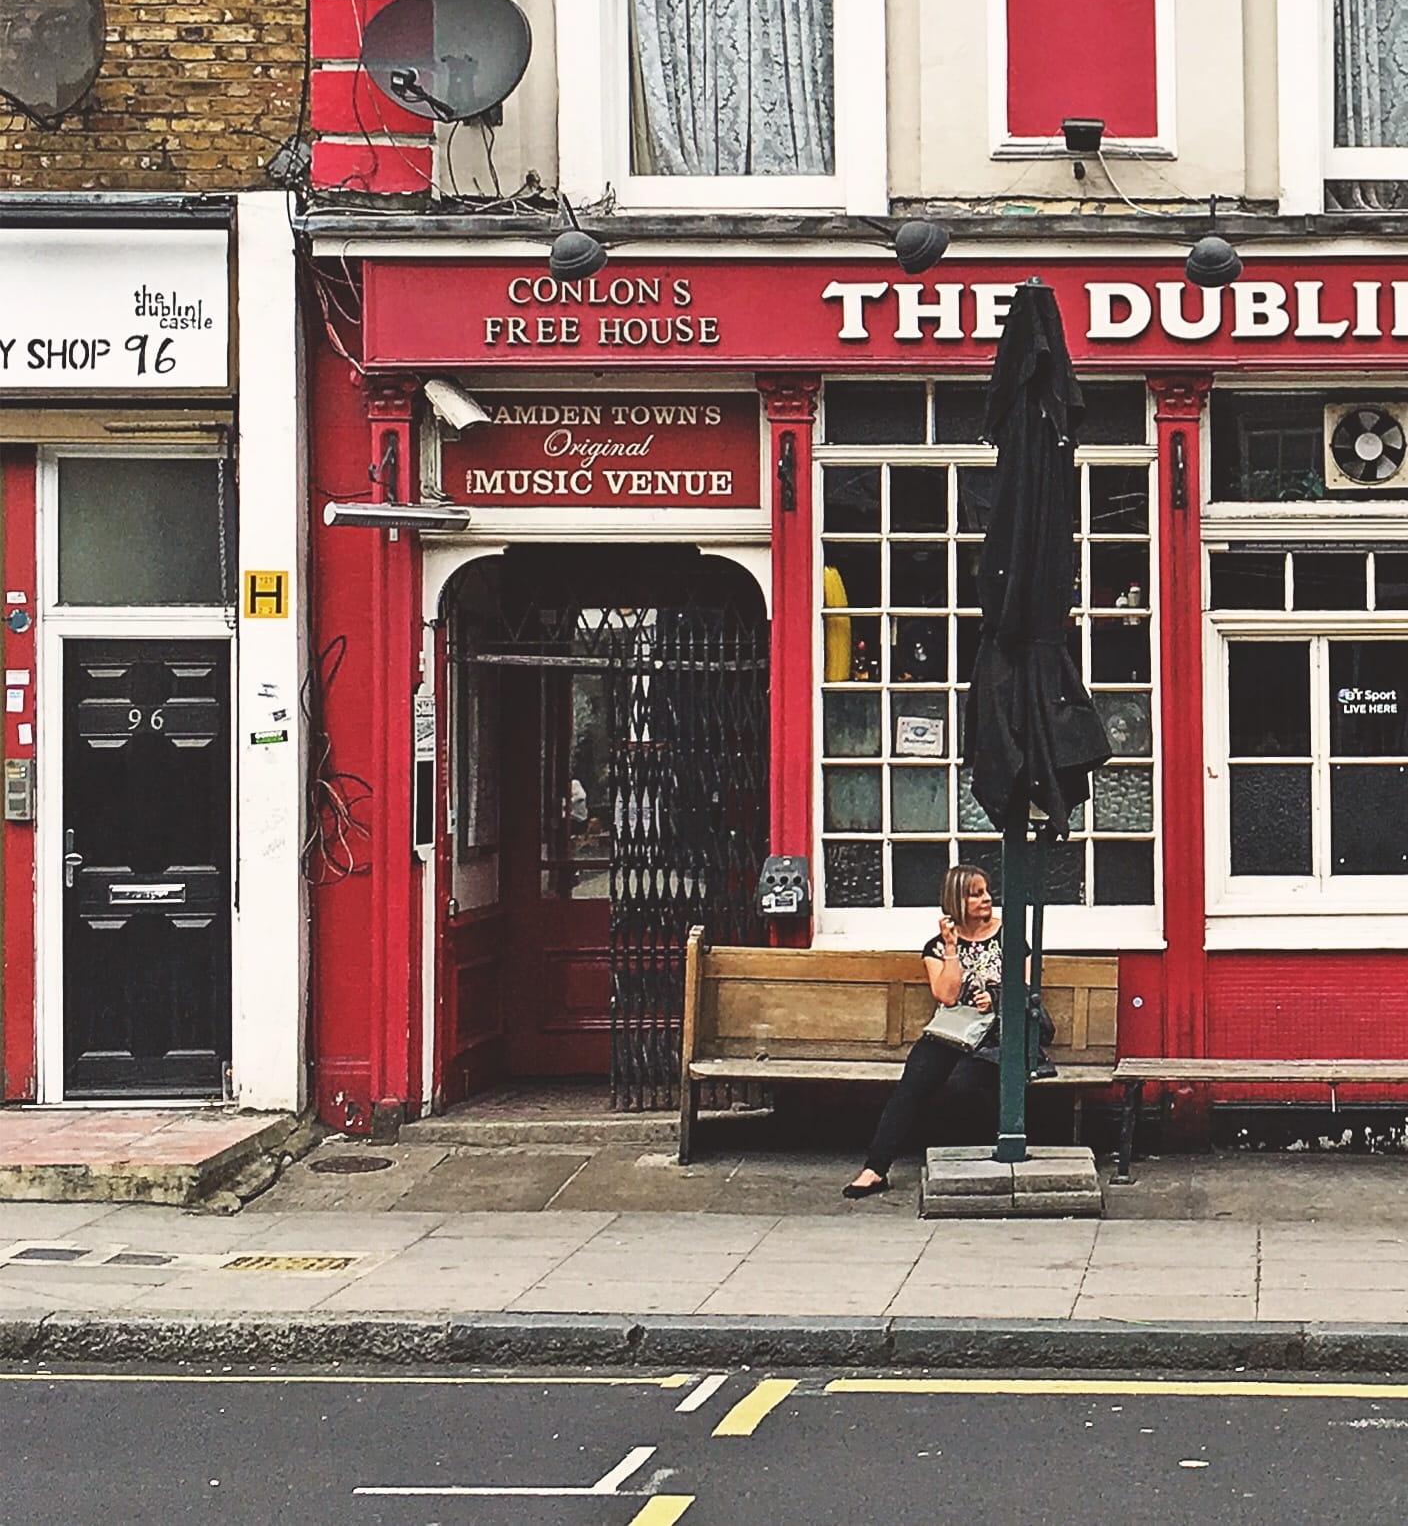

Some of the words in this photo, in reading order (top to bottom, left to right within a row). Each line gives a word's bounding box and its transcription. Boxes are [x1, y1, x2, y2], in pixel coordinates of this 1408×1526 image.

[134, 285, 164, 304] the
[135, 291, 195, 316] dublin
[159, 300, 213, 330] castle
[484, 317, 580, 344] FREE
[598, 315, 720, 344] HOUSE
[27, 339, 110, 370] SHOP
[125, 335, 176, 375] 96
[483, 405, 602, 425] AMDEN
[612, 405, 721, 426] TOWN'S
[544, 428, 653, 468] Original
[473, 469, 592, 494] MUSIC
[602, 469, 732, 495] VENUE
[1364, 689, 1397, 702] Sport
[128, 709, 164, 730] 96
[1343, 704, 1367, 714] LIVE
[1369, 704, 1398, 714] HERE
